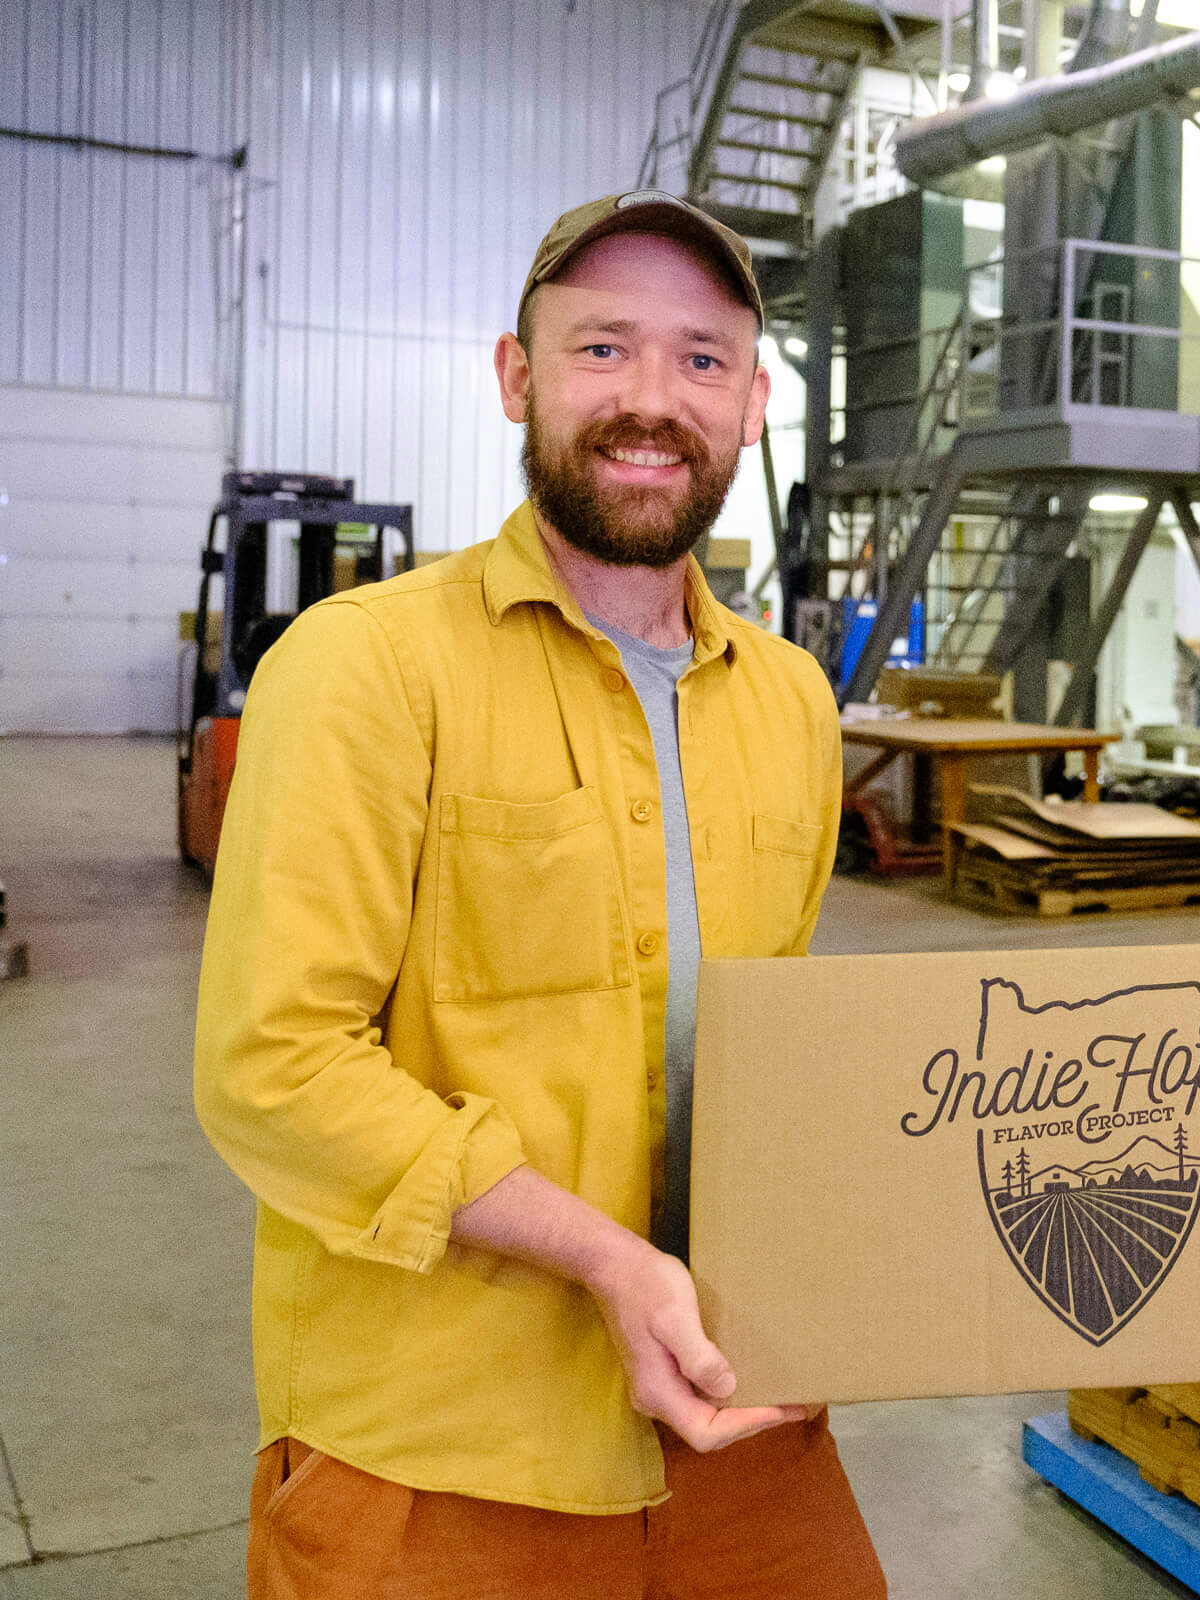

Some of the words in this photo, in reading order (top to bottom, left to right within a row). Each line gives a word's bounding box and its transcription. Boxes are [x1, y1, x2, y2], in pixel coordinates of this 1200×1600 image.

[901, 1048, 1088, 1136] Indie
[993, 1121, 1074, 1144] FLAVOR
[1086, 1107, 1175, 1132] PROJECT
